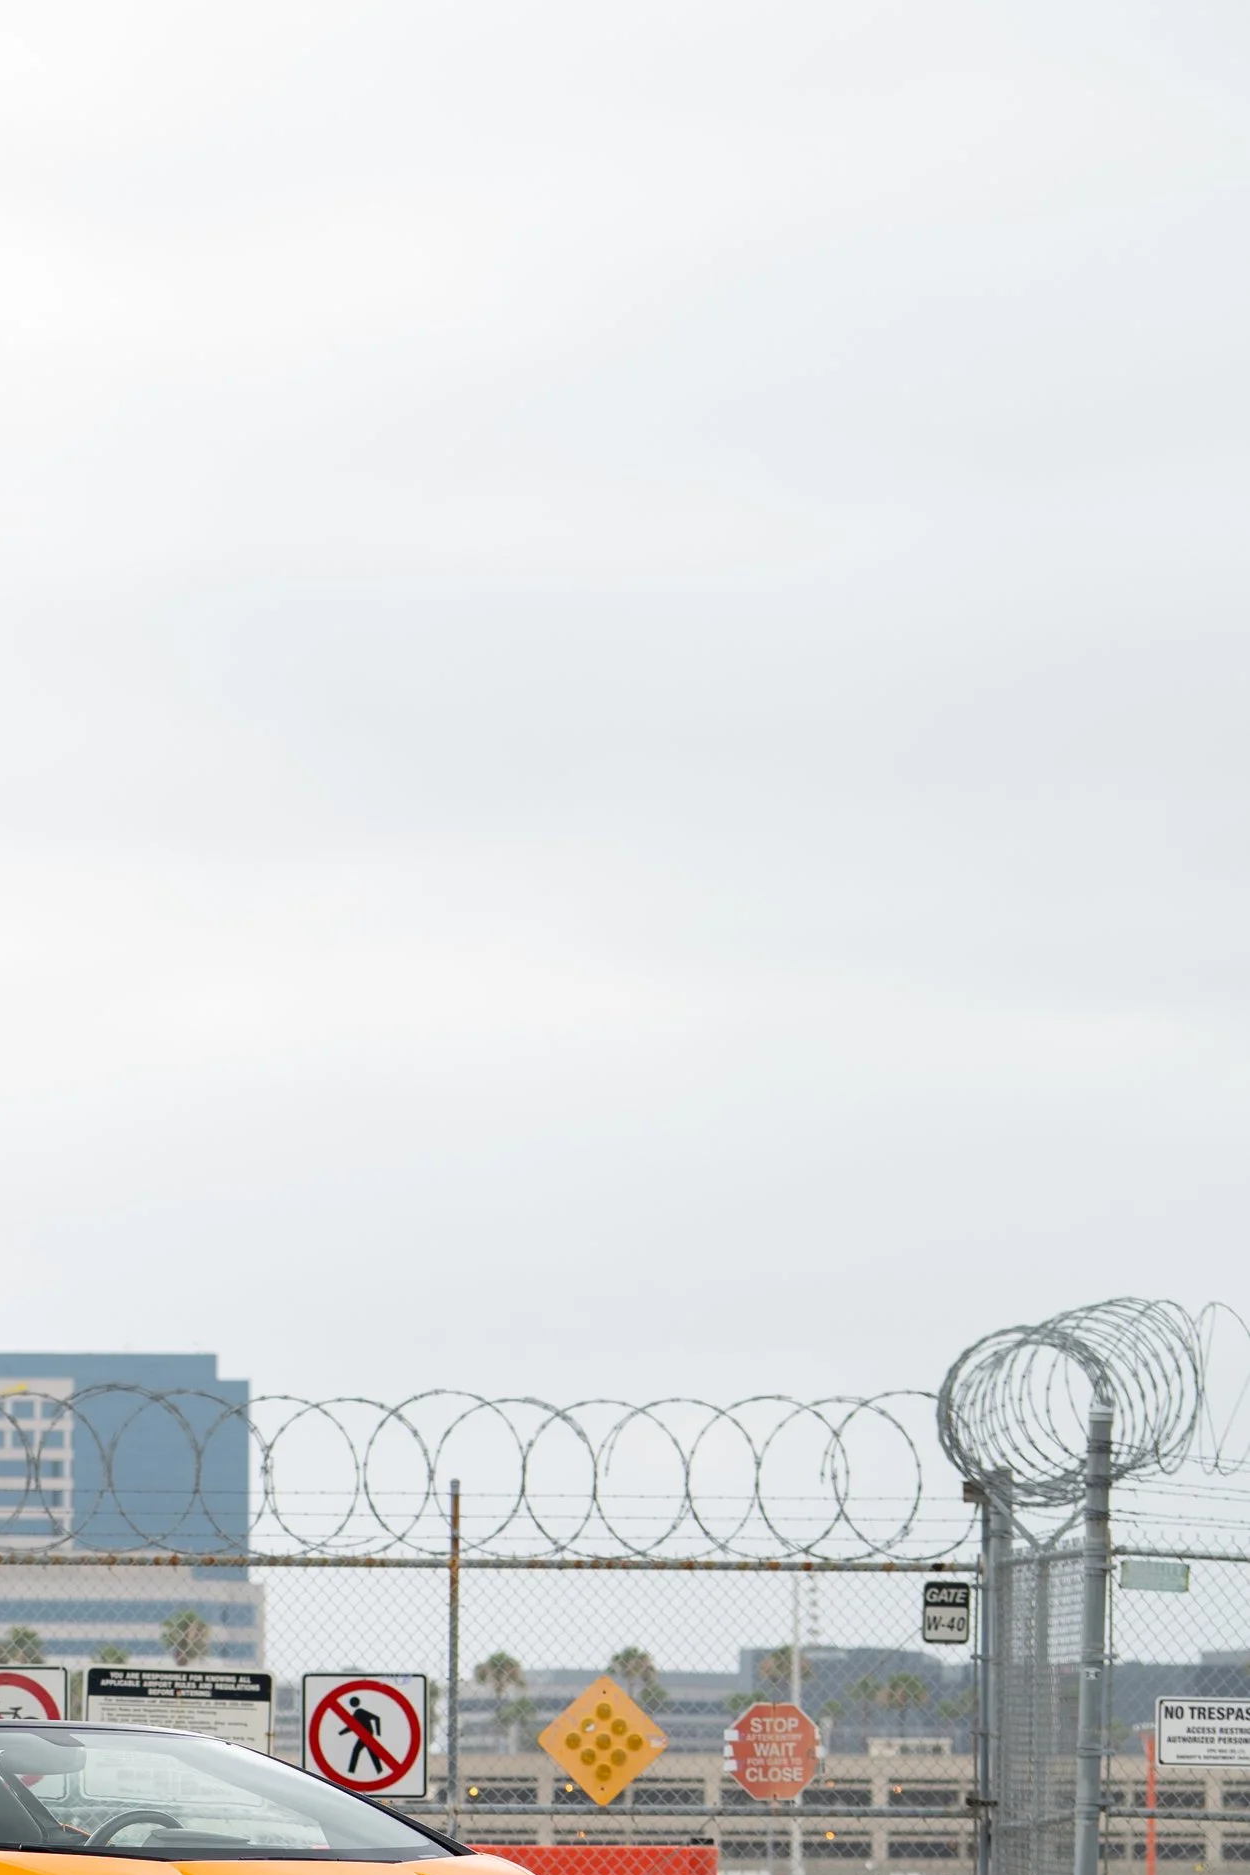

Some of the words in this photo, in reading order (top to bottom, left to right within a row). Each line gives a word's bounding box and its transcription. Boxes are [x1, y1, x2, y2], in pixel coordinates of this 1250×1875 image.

[925, 1587, 968, 1603] GATE
[927, 1615, 966, 1632] W-40
[100, 1678, 141, 1687] APPLICABLE
[142, 1680, 172, 1688] AIRPORT
[174, 1681, 196, 1689] RULES
[198, 1682, 213, 1690] AND
[214, 1683, 261, 1692] REGULATIONS
[109, 1671, 124, 1679] YOU
[125, 1672, 140, 1680] ARE
[141, 1672, 187, 1681] RESPONSIBLE
[189, 1674, 203, 1682] FOR
[204, 1675, 237, 1683] KNOWING
[238, 1676, 252, 1684] ALL
[147, 1688, 174, 1696] BEFORE
[1164, 1705, 1184, 1720] NO
[750, 1717, 799, 1733] STOP
[1186, 1726, 1216, 1734] ACCESS
[1166, 1735, 1216, 1744] AUTHORIZED
[753, 1742, 797, 1757] WAIT
[745, 1766, 804, 1782] CLOSE
